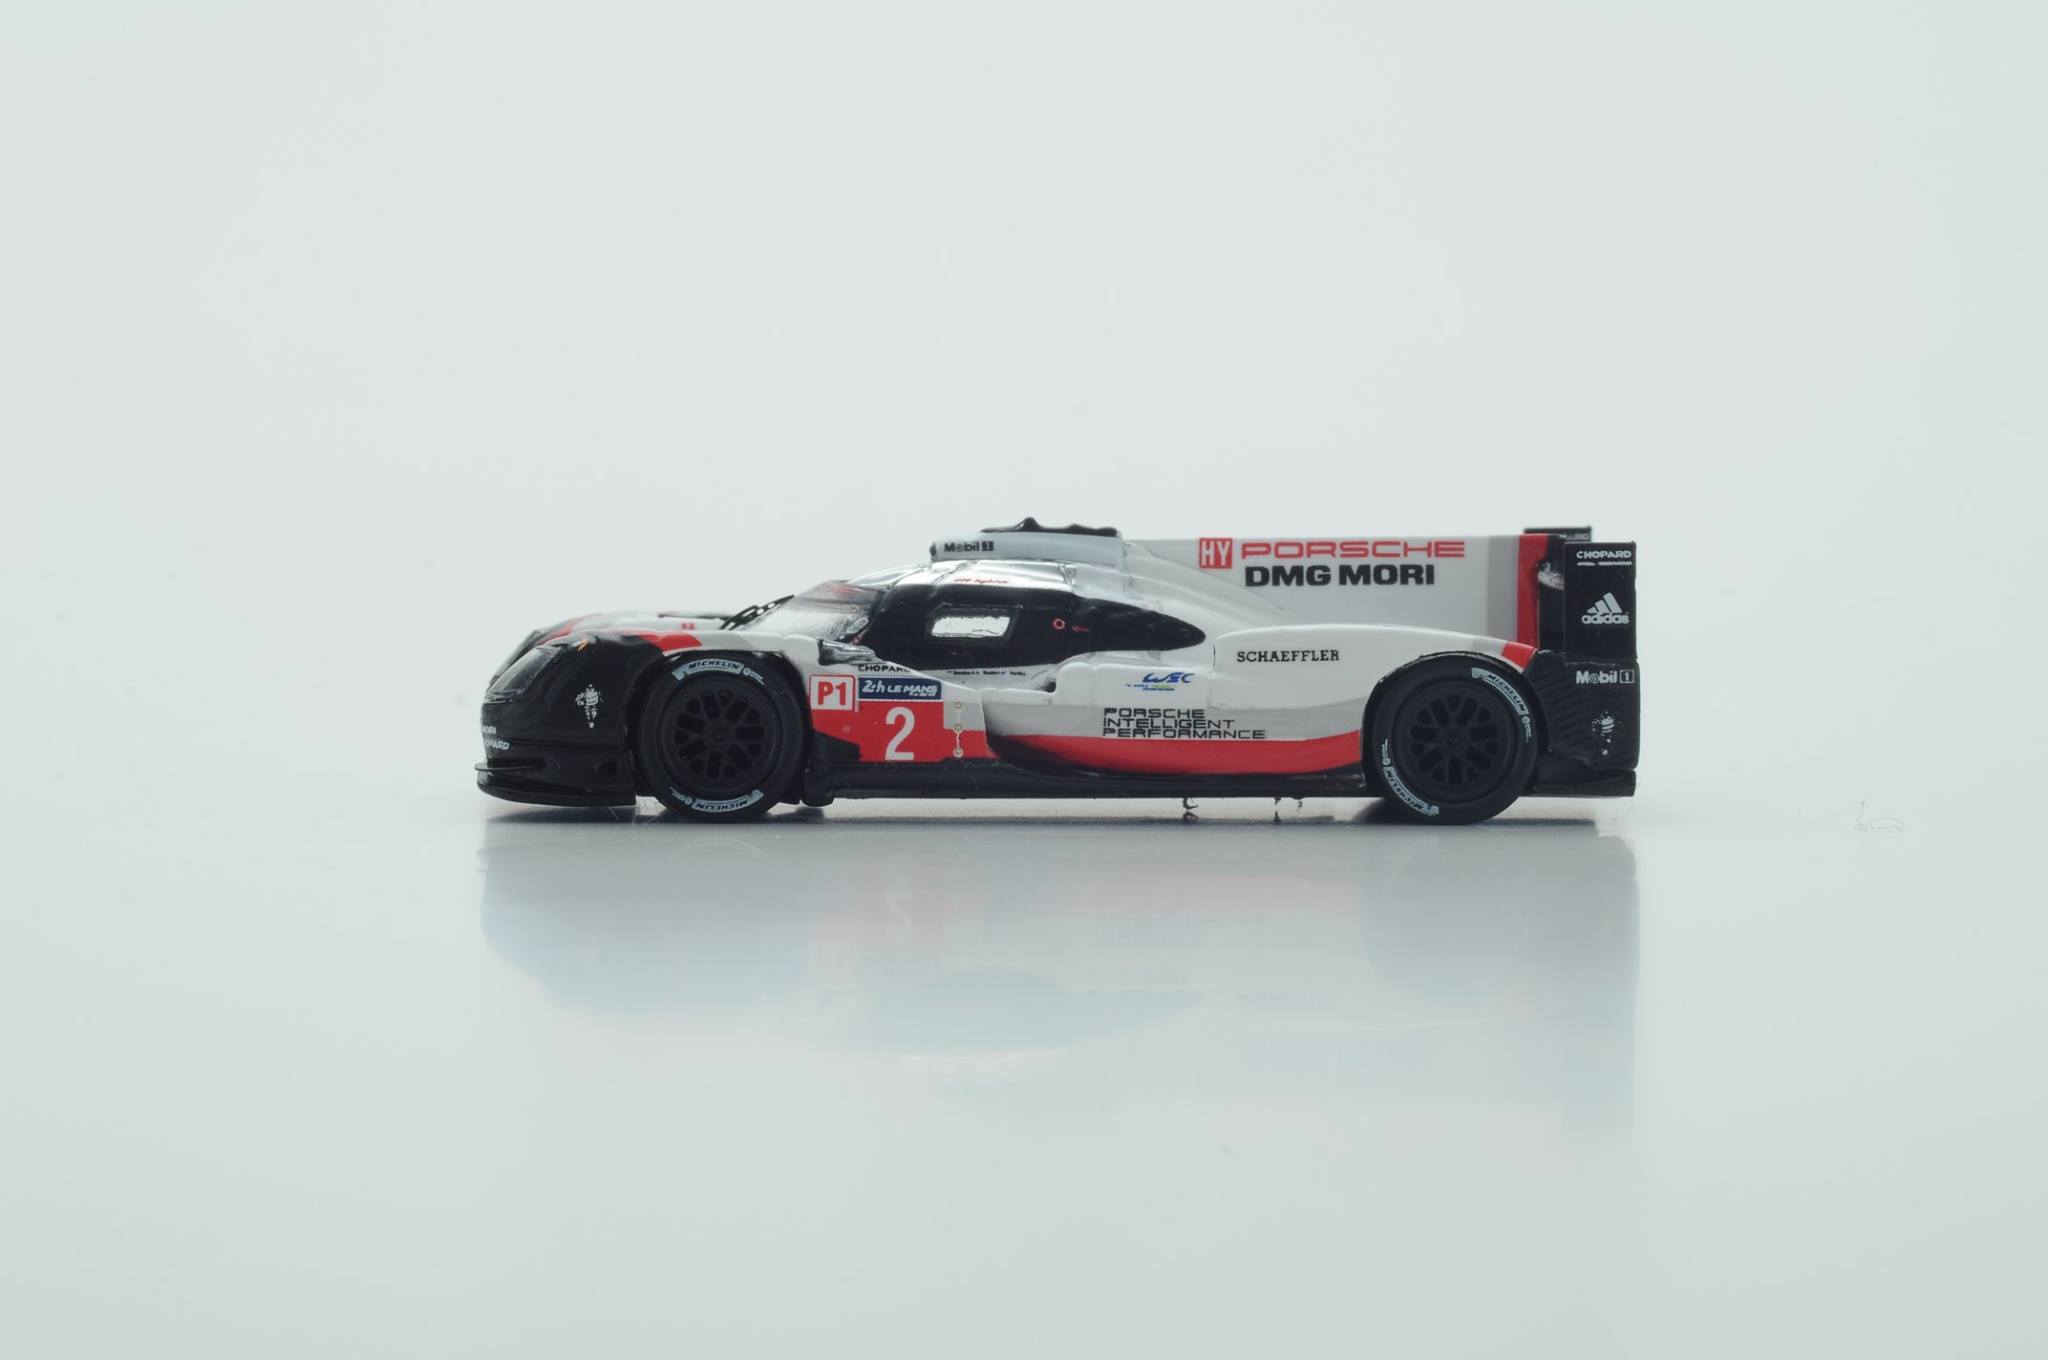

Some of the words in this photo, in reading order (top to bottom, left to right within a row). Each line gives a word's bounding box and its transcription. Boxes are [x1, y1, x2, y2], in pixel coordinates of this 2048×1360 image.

[944, 541, 980, 552] Mobil
[1200, 540, 1231, 566] HY
[1241, 541, 1465, 560] PORSCHE
[1576, 550, 1632, 559] CHOPARD
[1245, 565, 1331, 587] DMG
[1338, 564, 1435, 585] MORI
[1581, 613, 1630, 625] adidas
[1236, 650, 1340, 663] SCHAEFFLER
[688, 659, 740, 671] MICHELIN
[1142, 671, 1195, 683] WEC
[1575, 670, 1618, 684] Mobil
[817, 681, 847, 706] P1
[1486, 672, 1527, 712] MICHELIN
[1103, 707, 1206, 719] PORSCHE
[1103, 718, 1235, 729] INTELLIGENT
[885, 706, 915, 760] 2
[1103, 728, 1267, 739] PERFORMANCE
